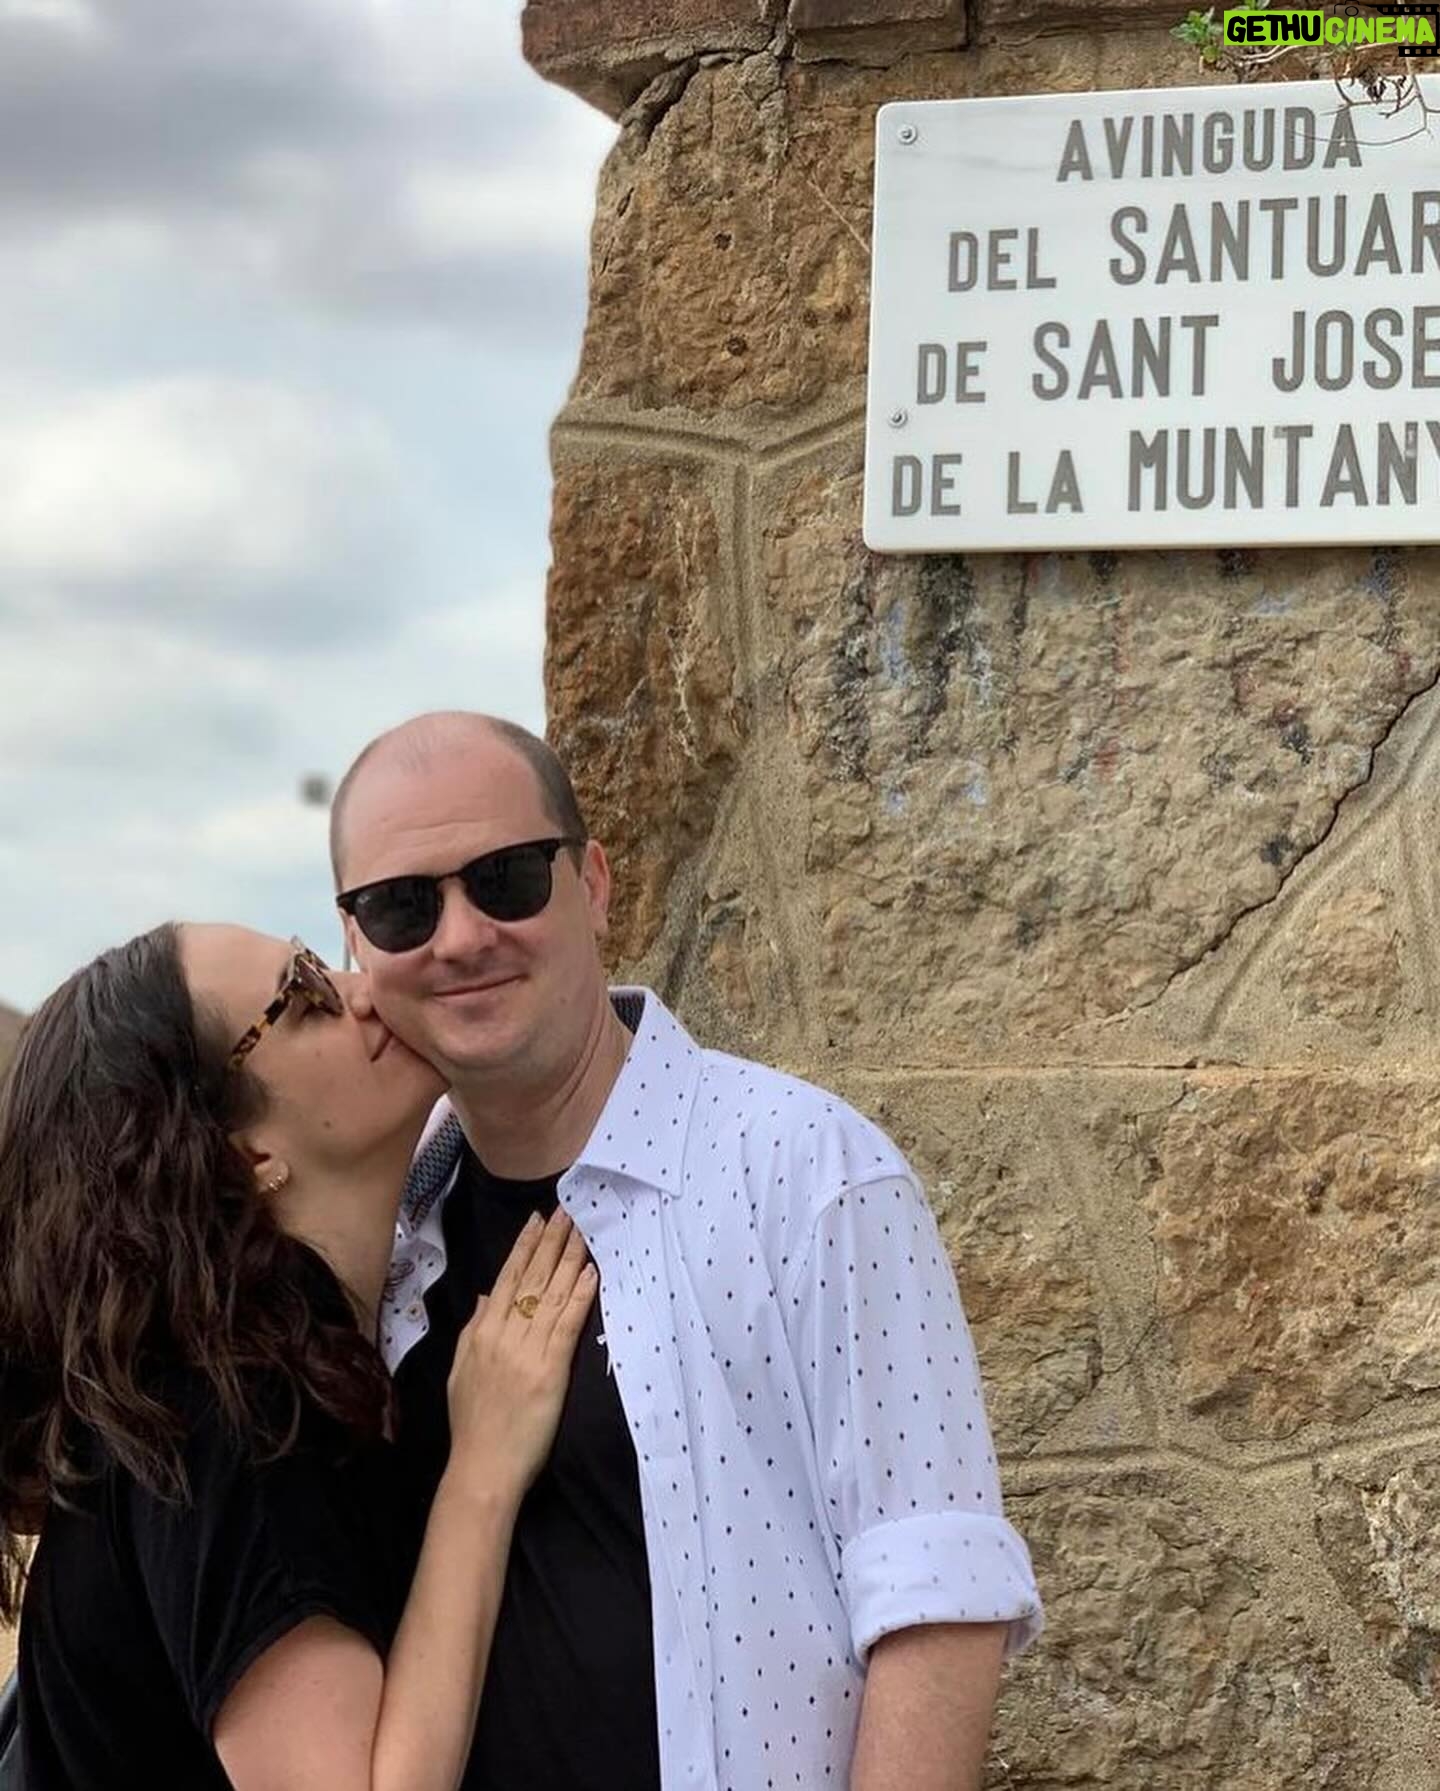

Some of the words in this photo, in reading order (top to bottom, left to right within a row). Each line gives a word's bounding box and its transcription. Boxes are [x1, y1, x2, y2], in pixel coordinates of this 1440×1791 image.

[1056, 106, 1362, 182] AVINGUDA
[948, 228, 1056, 291] DEL
[1109, 191, 1440, 285] SANTUAR
[916, 342, 987, 404] DE
[1032, 314, 1219, 400] SANT
[1272, 306, 1440, 392] JOSE
[891, 454, 962, 517] DE
[1007, 450, 1084, 514] LA
